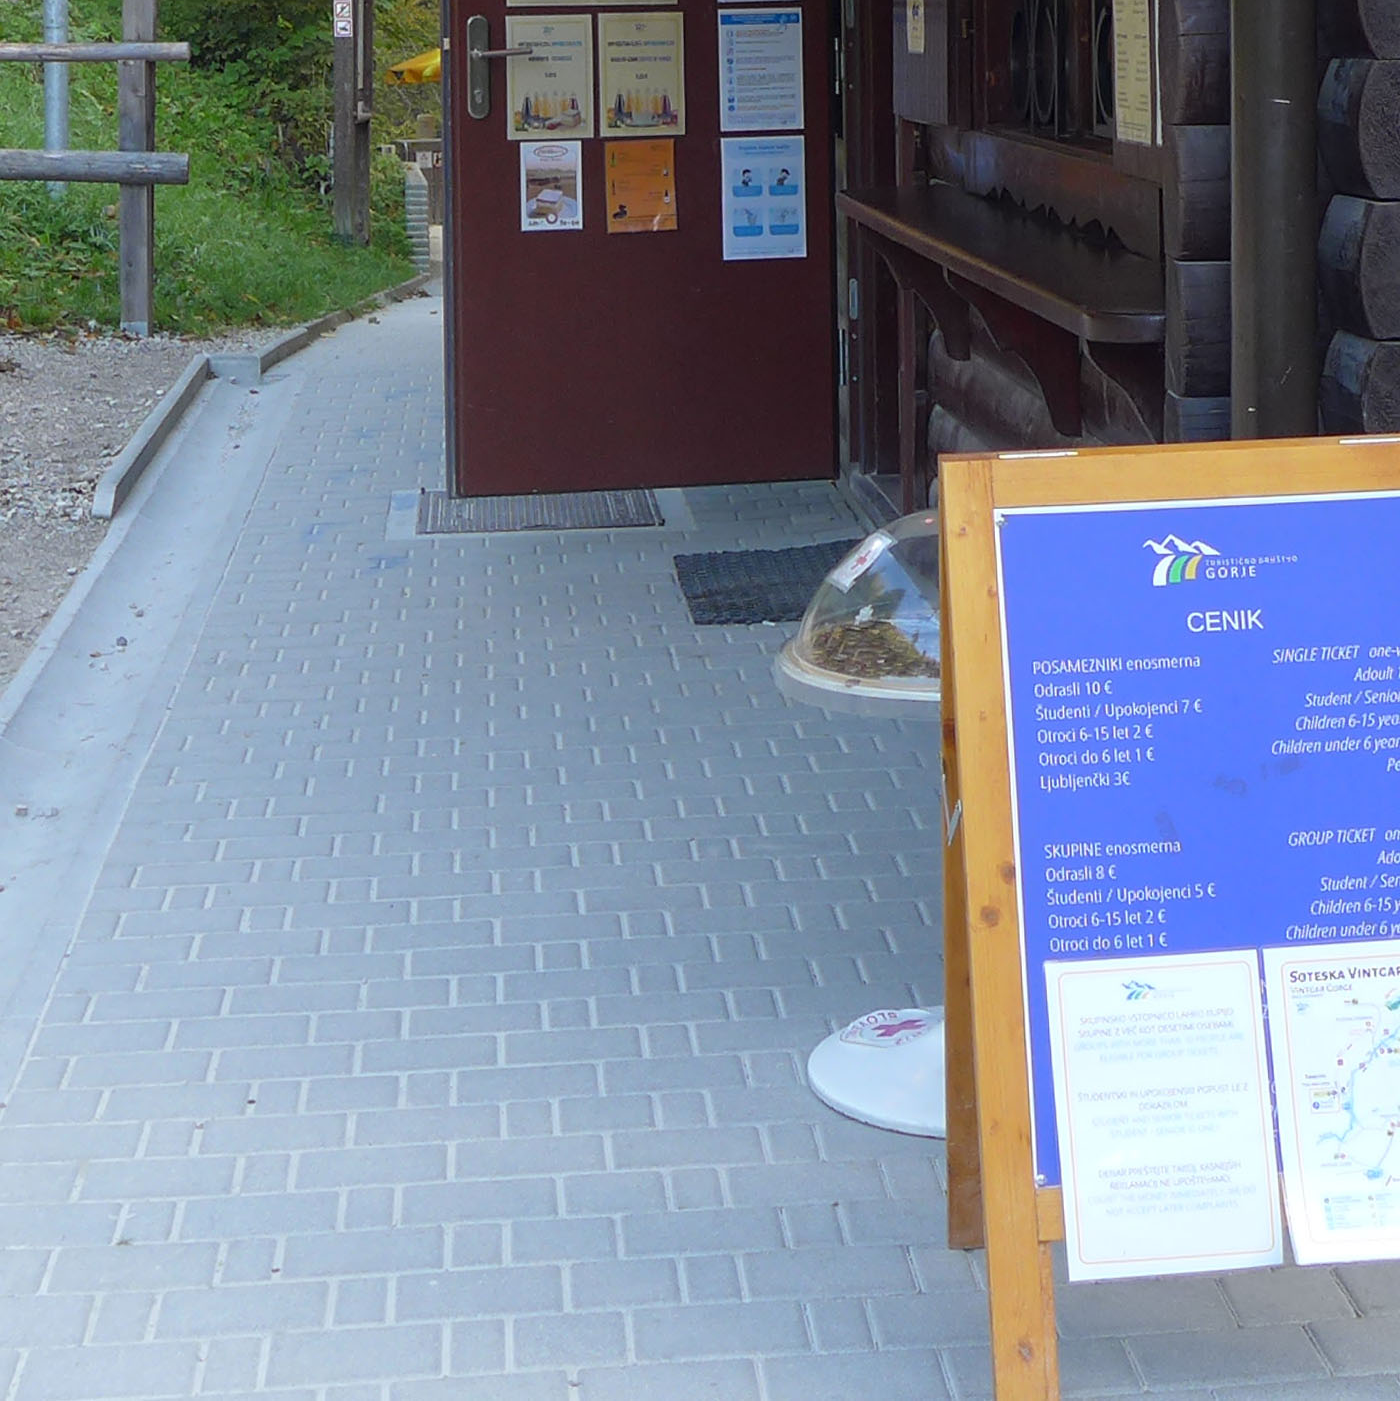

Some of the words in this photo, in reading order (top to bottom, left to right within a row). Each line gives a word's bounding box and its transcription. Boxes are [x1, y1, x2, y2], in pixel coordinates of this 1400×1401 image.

[1205, 565, 1257, 579] GORJE
[1186, 608, 1264, 633] CENIK
[1272, 646, 1319, 664] SINGLE
[1320, 644, 1361, 661] TICKET
[1032, 656, 1123, 676] POSAMEZNIKI
[1126, 655, 1201, 671] enosmerna
[1034, 681, 1081, 699] Odrasli
[1085, 680, 1102, 696] 10
[1104, 679, 1113, 695] €
[1304, 691, 1353, 708] Student
[1035, 704, 1091, 722] Študenti
[1104, 699, 1179, 721] Upokojenci
[1181, 698, 1190, 714] 7
[1193, 698, 1203, 713] €
[1294, 714, 1346, 731] Children
[1347, 712, 1376, 729] 6-15
[1036, 727, 1076, 745] Otroci
[1078, 725, 1110, 743] 6-15
[1112, 725, 1130, 740] let
[1132, 724, 1142, 740] 2
[1144, 723, 1154, 739] €
[1271, 738, 1322, 756] Children
[1324, 736, 1362, 752] under
[1362, 734, 1372, 751] 6
[1038, 750, 1078, 767] Otroci
[1080, 749, 1099, 765] do
[1101, 748, 1112, 764] 6
[1113, 747, 1132, 763] let
[1146, 746, 1155, 762] €
[1040, 771, 1110, 794] Ljubljenčki
[1113, 770, 1132, 786] 3€
[1288, 829, 1334, 847] GROUP
[1336, 827, 1377, 844] TICKET
[1044, 841, 1102, 860] SKUPINE
[1105, 840, 1182, 857] enosmerna
[1045, 864, 1093, 883] Odrasli
[1095, 864, 1106, 880] 8
[1108, 864, 1117, 880] €
[1320, 875, 1368, 892] Student
[1046, 888, 1102, 906] Študenti
[1116, 884, 1192, 905] Upokojenci
[1194, 883, 1204, 899] 5
[1206, 882, 1217, 898] €
[1310, 898, 1362, 916] Children
[1363, 896, 1392, 914] 6-15
[1048, 912, 1088, 929] Otroci
[1090, 910, 1122, 927] 6-15
[1124, 909, 1142, 926] let
[1145, 909, 1154, 924] 2
[1157, 908, 1167, 924] €
[1285, 923, 1338, 942] Children
[1340, 920, 1378, 938] under
[1378, 920, 1388, 936] 6
[1049, 936, 1089, 953] Otroci
[1092, 935, 1111, 951] do
[1113, 934, 1124, 950] 6
[1126, 933, 1144, 950] let
[1158, 931, 1168, 948] €
